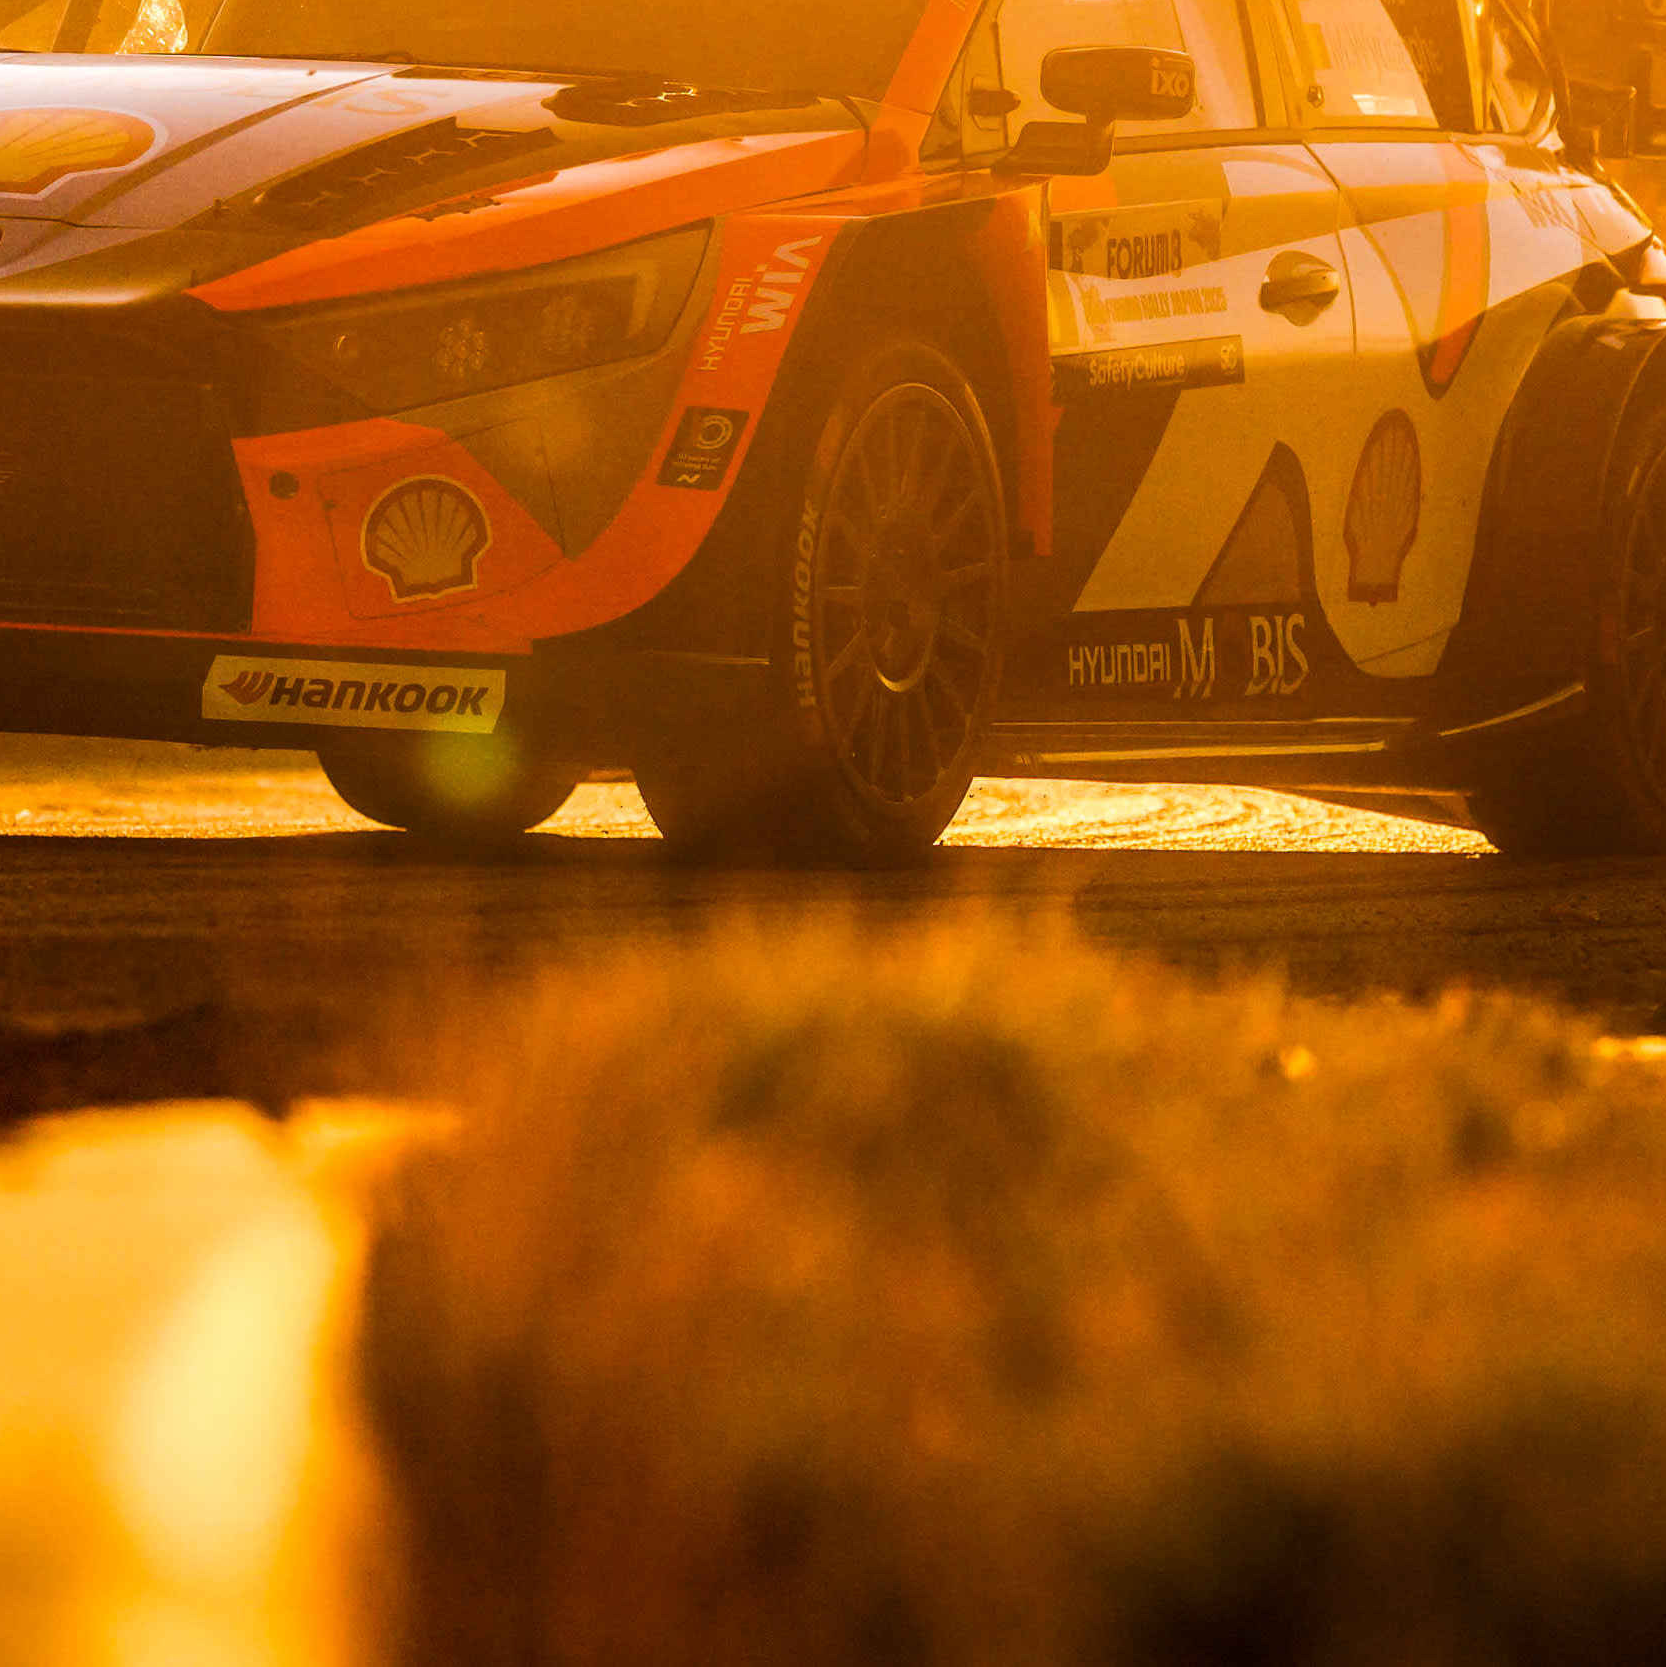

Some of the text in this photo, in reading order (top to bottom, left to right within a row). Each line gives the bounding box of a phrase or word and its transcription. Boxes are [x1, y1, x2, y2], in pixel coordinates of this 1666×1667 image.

[699, 277, 753, 371] HYUNDAI
[1088, 350, 1185, 388] SafetyCulture
[1068, 642, 1171, 685] HYUNDAI
